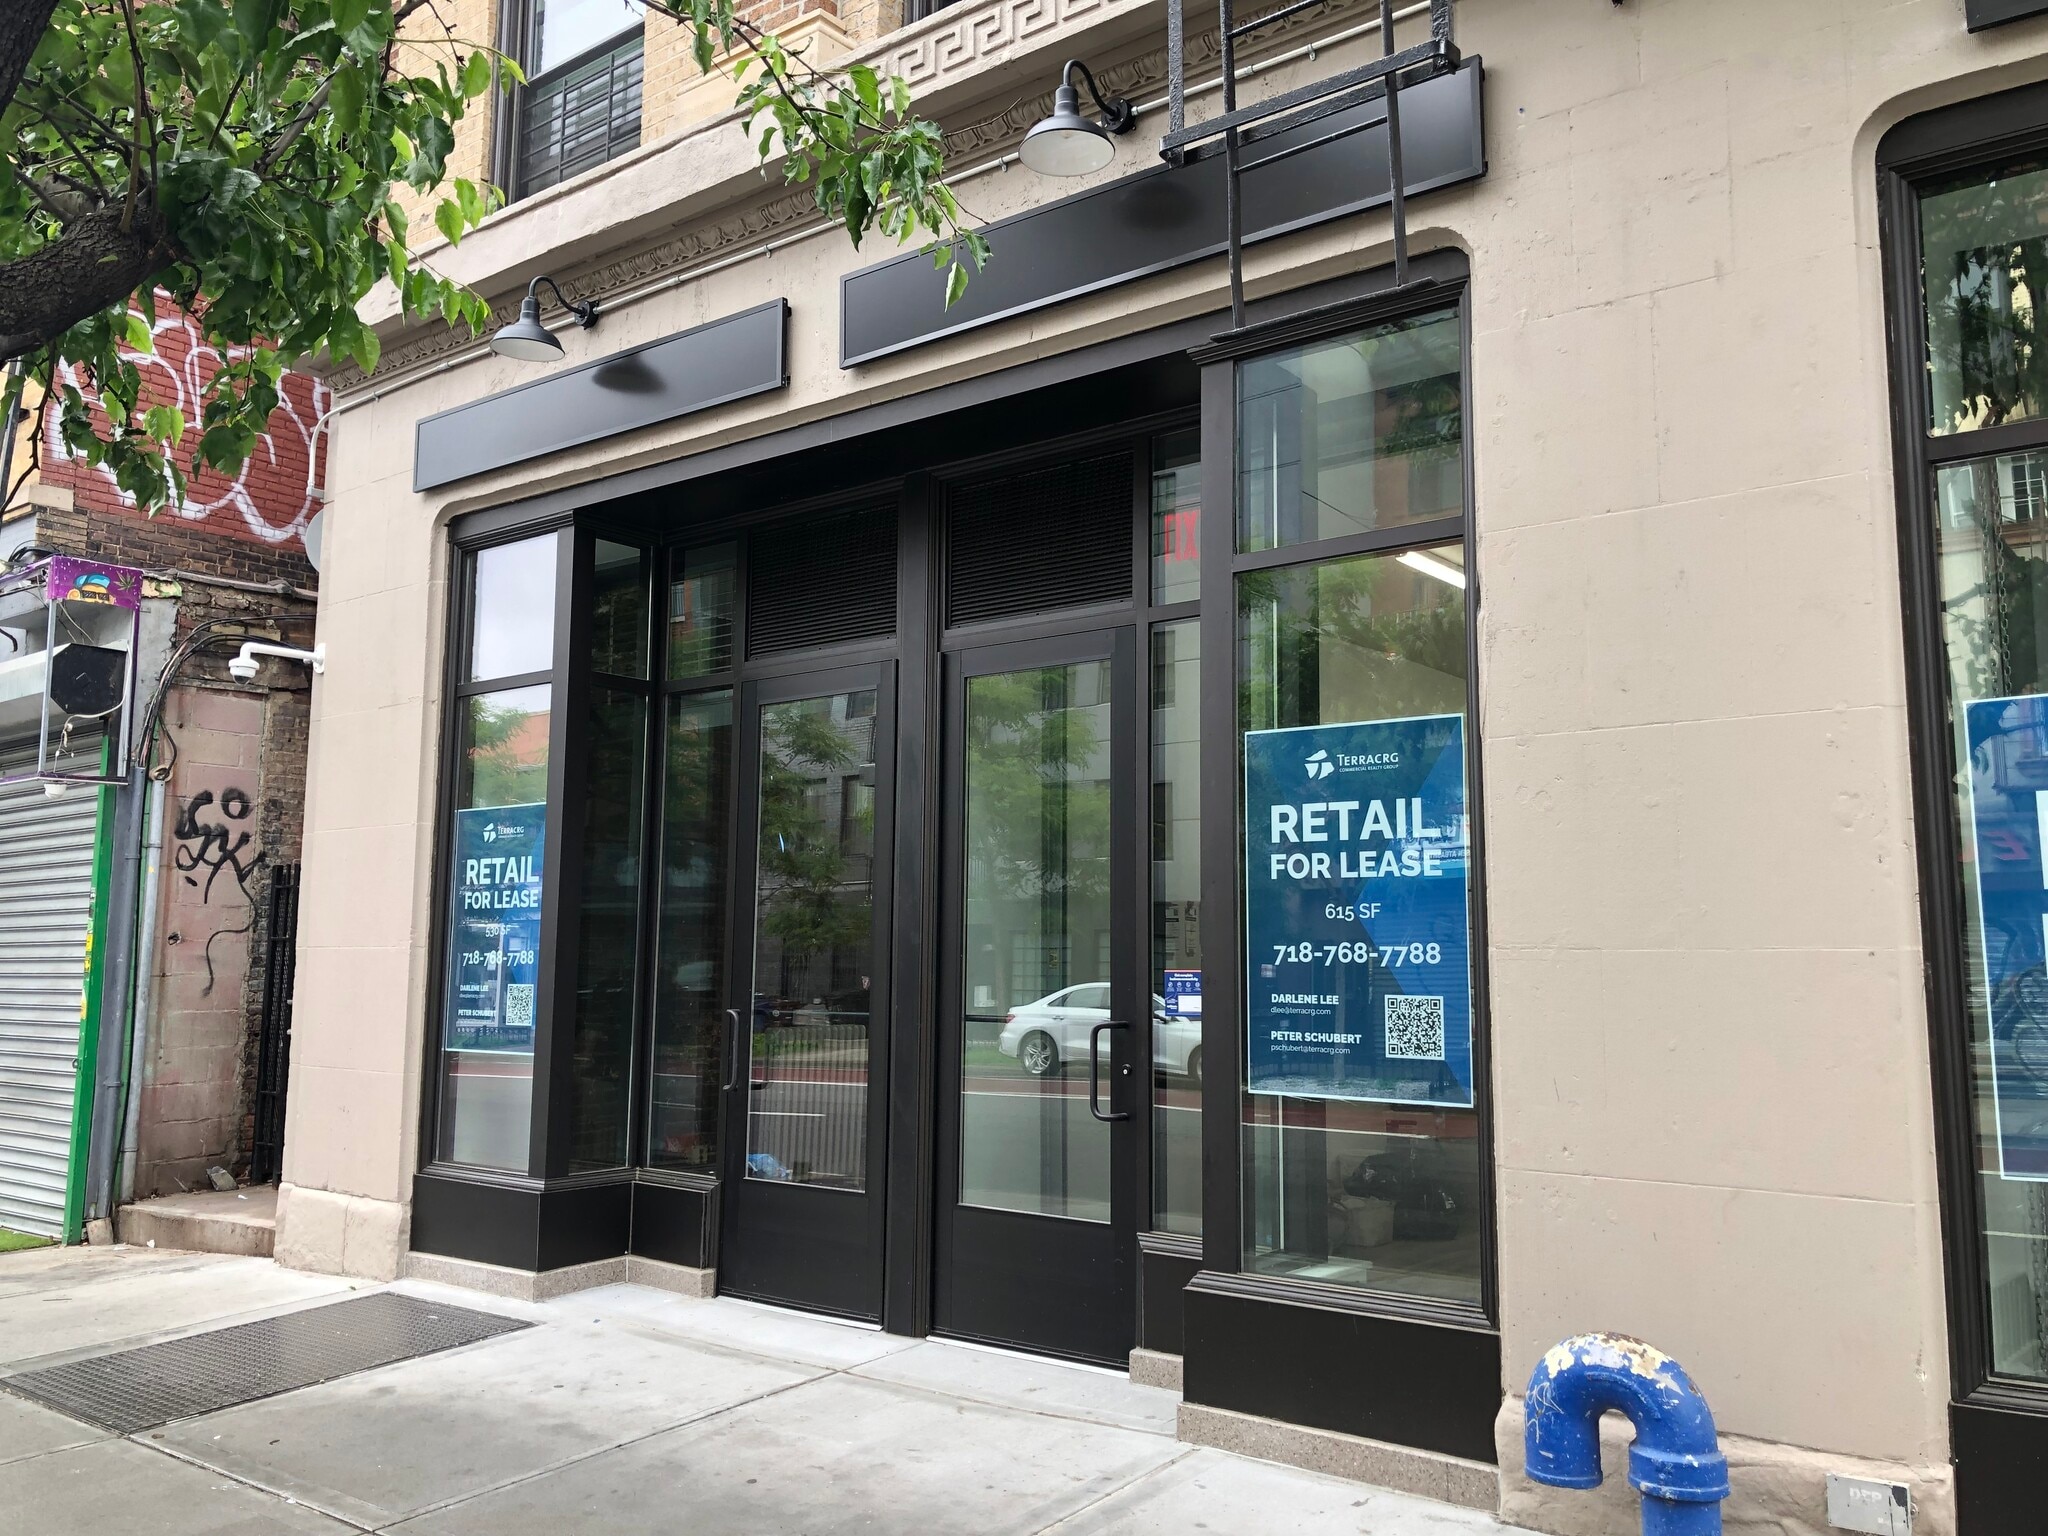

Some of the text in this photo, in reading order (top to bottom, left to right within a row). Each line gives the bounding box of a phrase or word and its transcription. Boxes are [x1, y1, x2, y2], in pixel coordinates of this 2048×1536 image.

[1271, 797, 1441, 843] RETAIL
[466, 855, 540, 885] RETAIL
[1271, 848, 1443, 880] FOR LEASE
[464, 889, 539, 910] FOR LEASE
[1325, 903, 1381, 922] 615 SF
[462, 950, 534, 967] 718-768-7788
[1273, 941, 1441, 968] 718-768-7788
[1271, 994, 1340, 1005] DARLENE LEE
[1270, 1006, 1331, 1016] dlee@terracrg.com
[1270, 1031, 1362, 1044] PETER SCHUBERT
[1271, 1045, 1351, 1055] pschubert@terracrg.com
